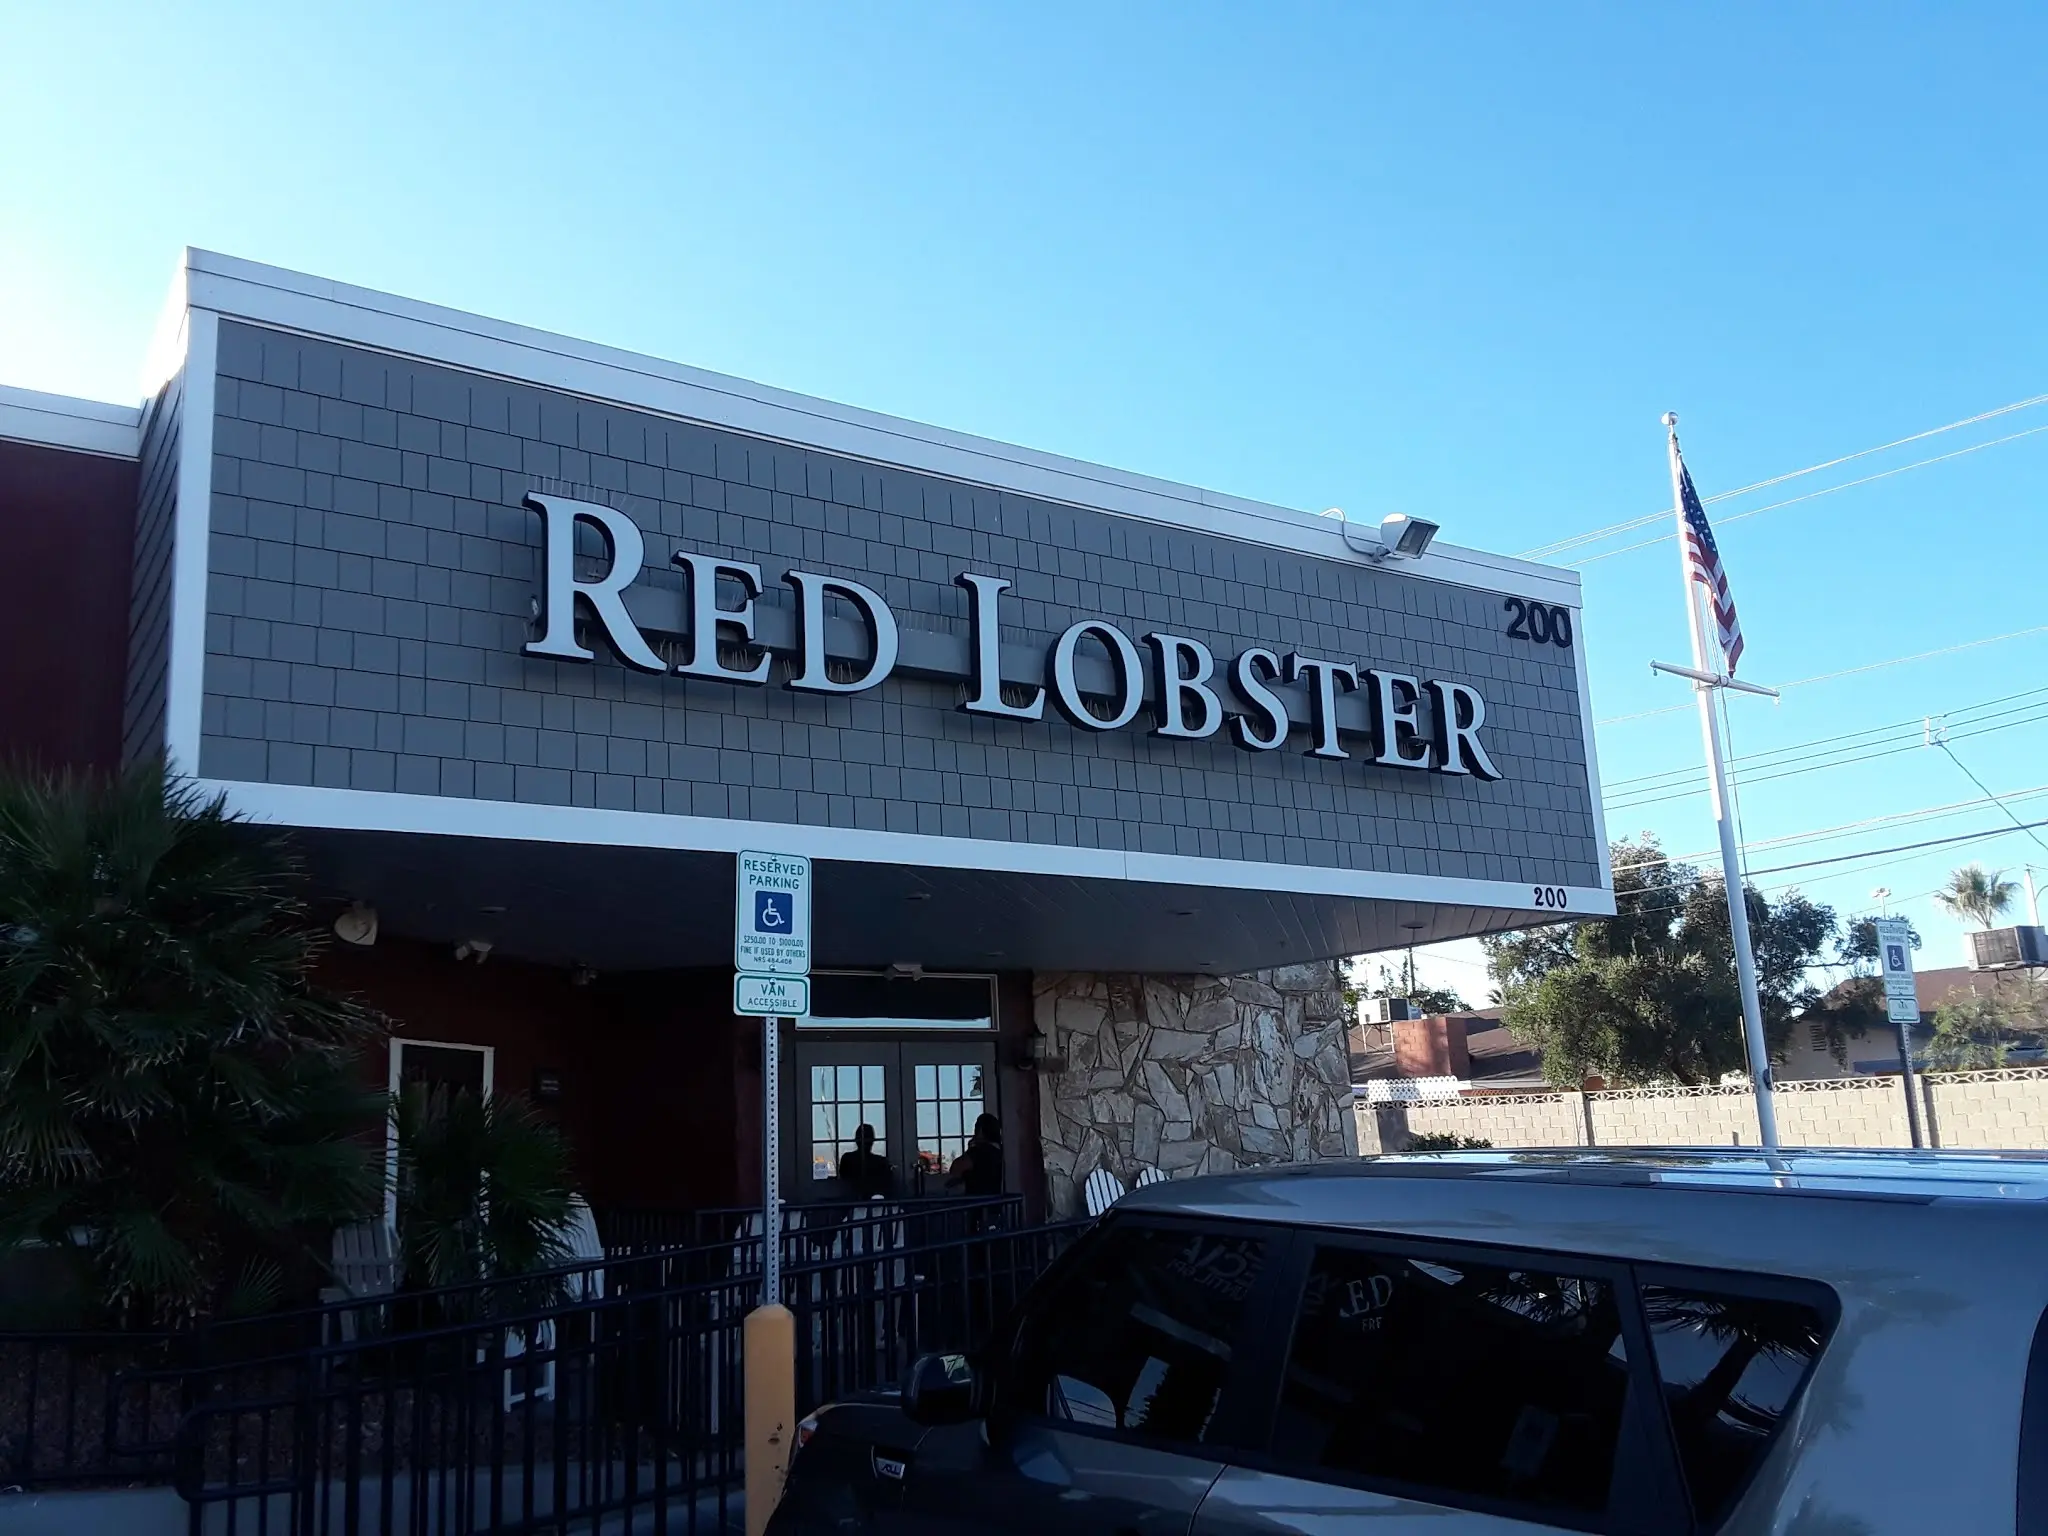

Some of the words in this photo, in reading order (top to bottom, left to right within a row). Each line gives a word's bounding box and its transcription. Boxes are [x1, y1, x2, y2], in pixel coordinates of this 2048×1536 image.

[1504, 597, 1573, 649] 200
[521, 490, 899, 697] RED
[955, 571, 1503, 781] LOBSTER
[744, 859, 805, 876] RESERVED
[749, 874, 800, 890] PARKING
[1533, 886, 1567, 909] 200
[769, 937, 776, 945] TO
[740, 945, 752, 954] FINE
[753, 946, 760, 954] IF
[761, 947, 775, 956] USED
[786, 949, 806, 958] OTHERS
[760, 983, 785, 997] VAN
[747, 997, 798, 1008] ACCESSIBLE
